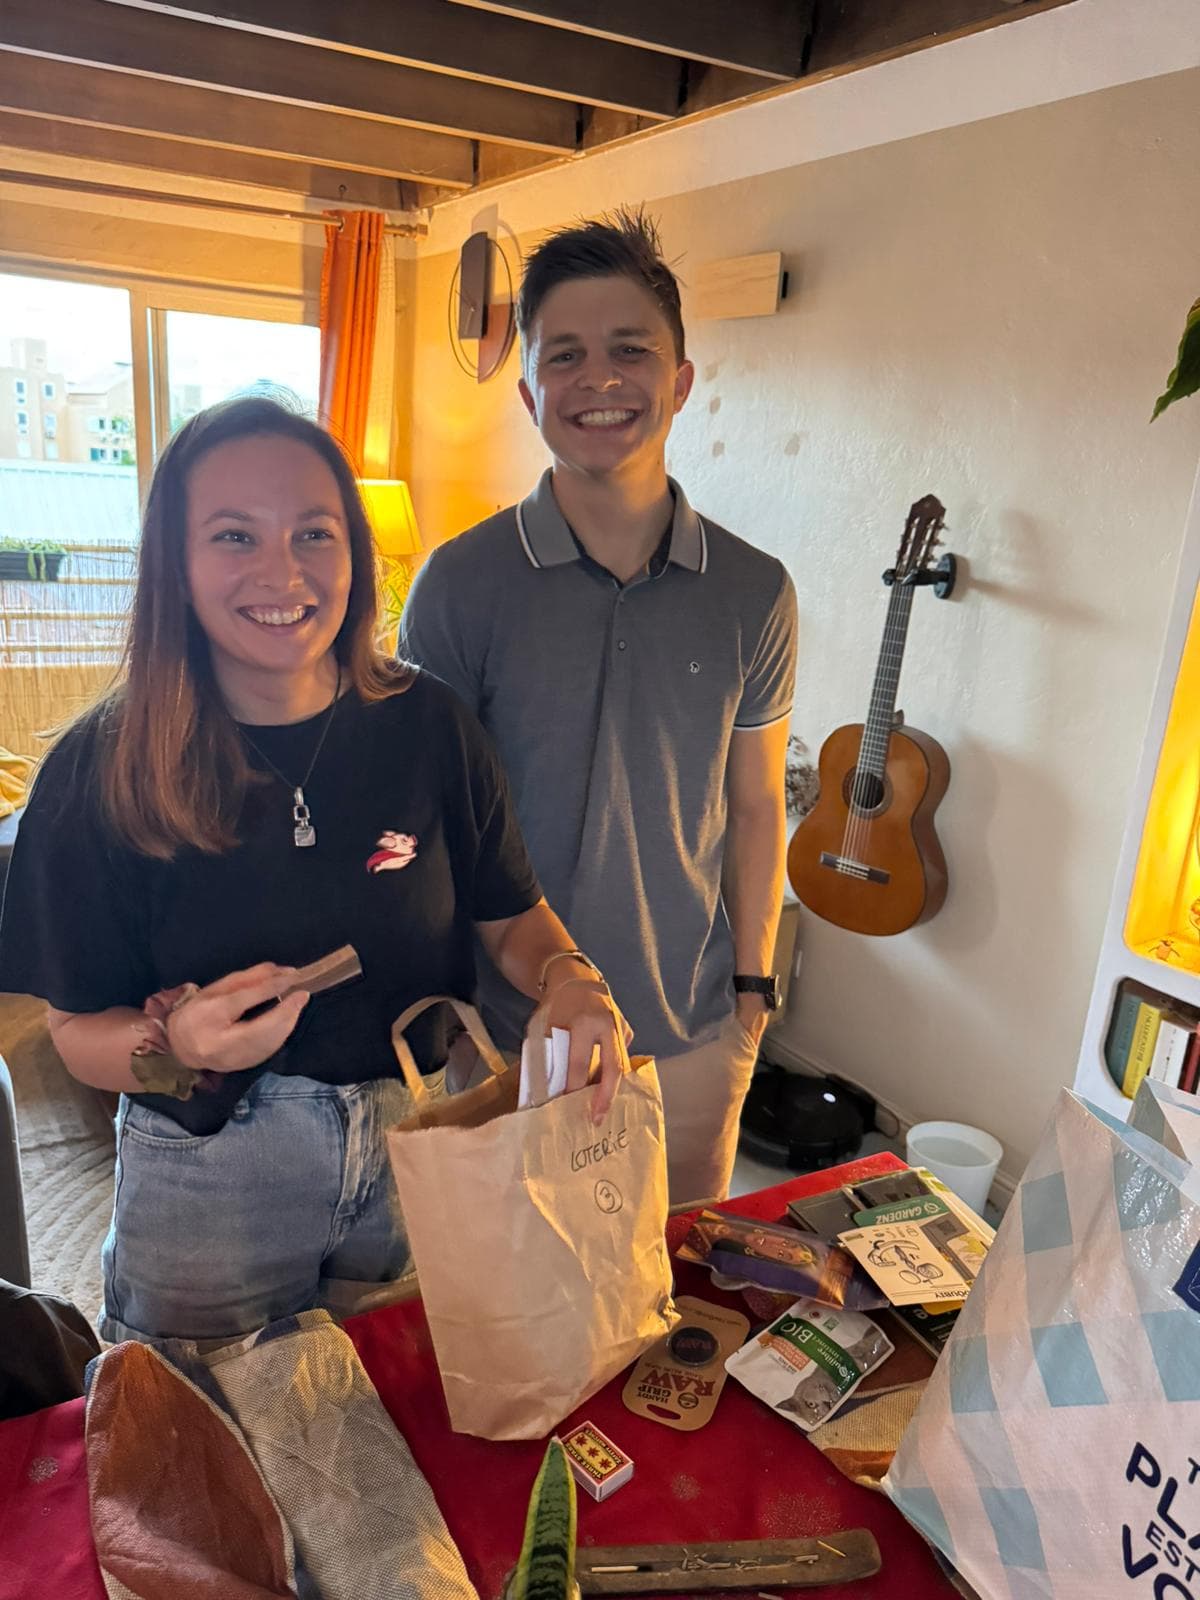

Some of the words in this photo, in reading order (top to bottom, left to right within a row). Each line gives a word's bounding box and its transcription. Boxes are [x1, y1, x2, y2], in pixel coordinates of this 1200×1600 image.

[598, 1184, 617, 1213] 3
[876, 1206, 922, 1225] GARDENZ
[780, 1321, 814, 1344] BIO
[638, 1384, 672, 1398] GRIP
[641, 1369, 716, 1397] RAW
[636, 1391, 669, 1404] HANDY
[1126, 1441, 1200, 1550] PL
[1145, 1520, 1200, 1583] EST
